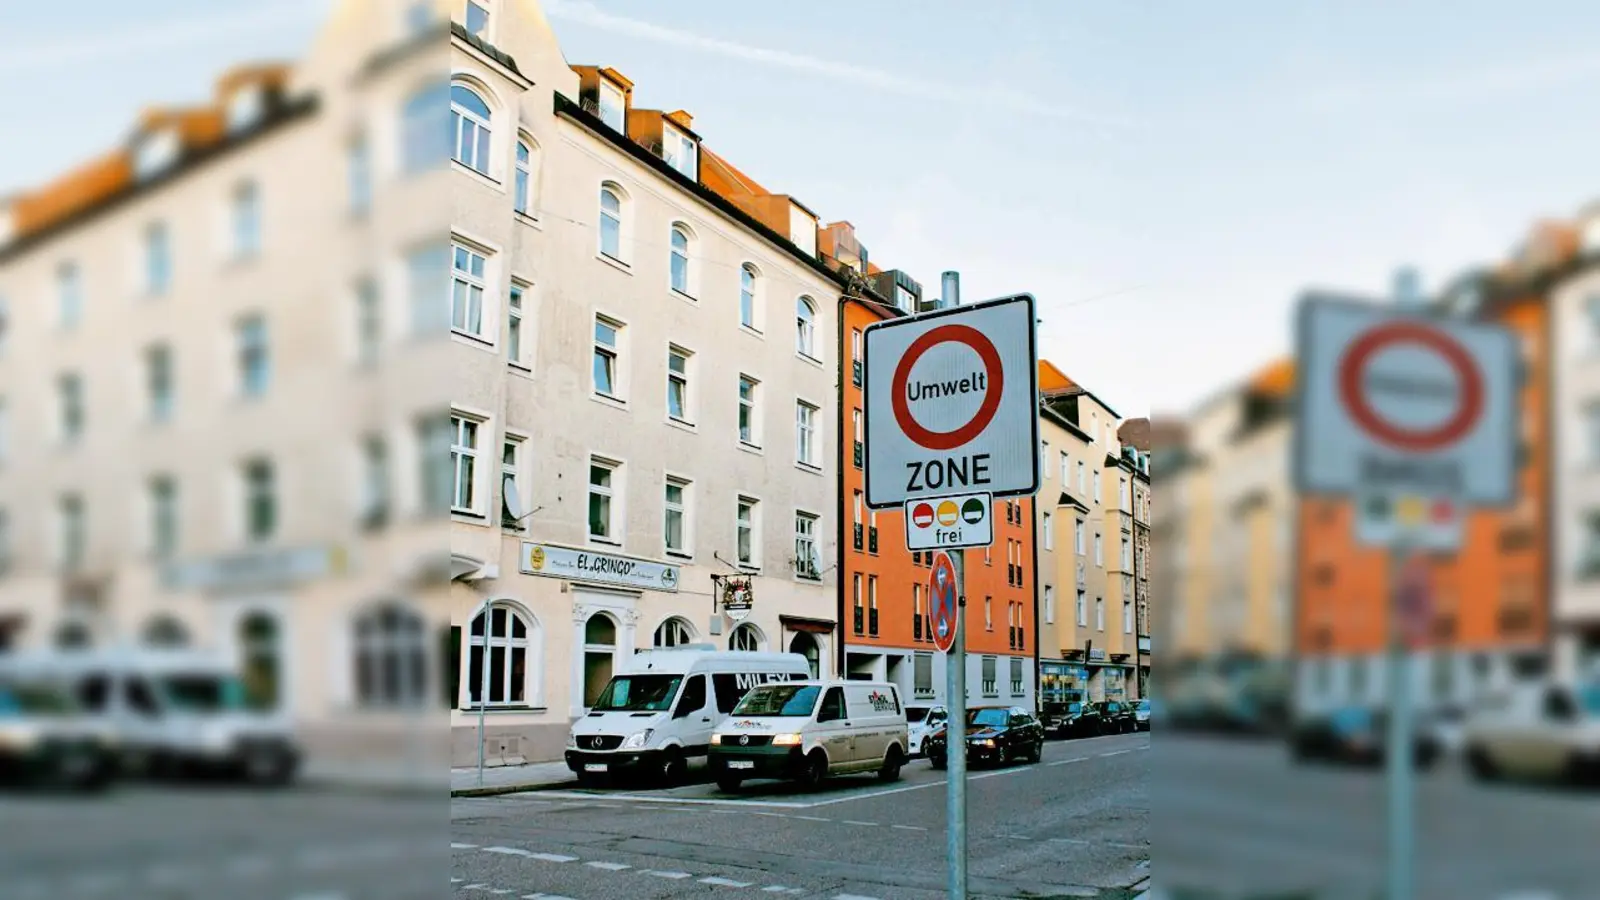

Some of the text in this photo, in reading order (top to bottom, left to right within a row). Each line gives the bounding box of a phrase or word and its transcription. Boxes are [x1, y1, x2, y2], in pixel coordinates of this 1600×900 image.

[907, 372, 986, 401] Umwelt
[906, 453, 991, 492] ZONE
[935, 527, 963, 544] frei
[577, 553, 589, 571] EL
